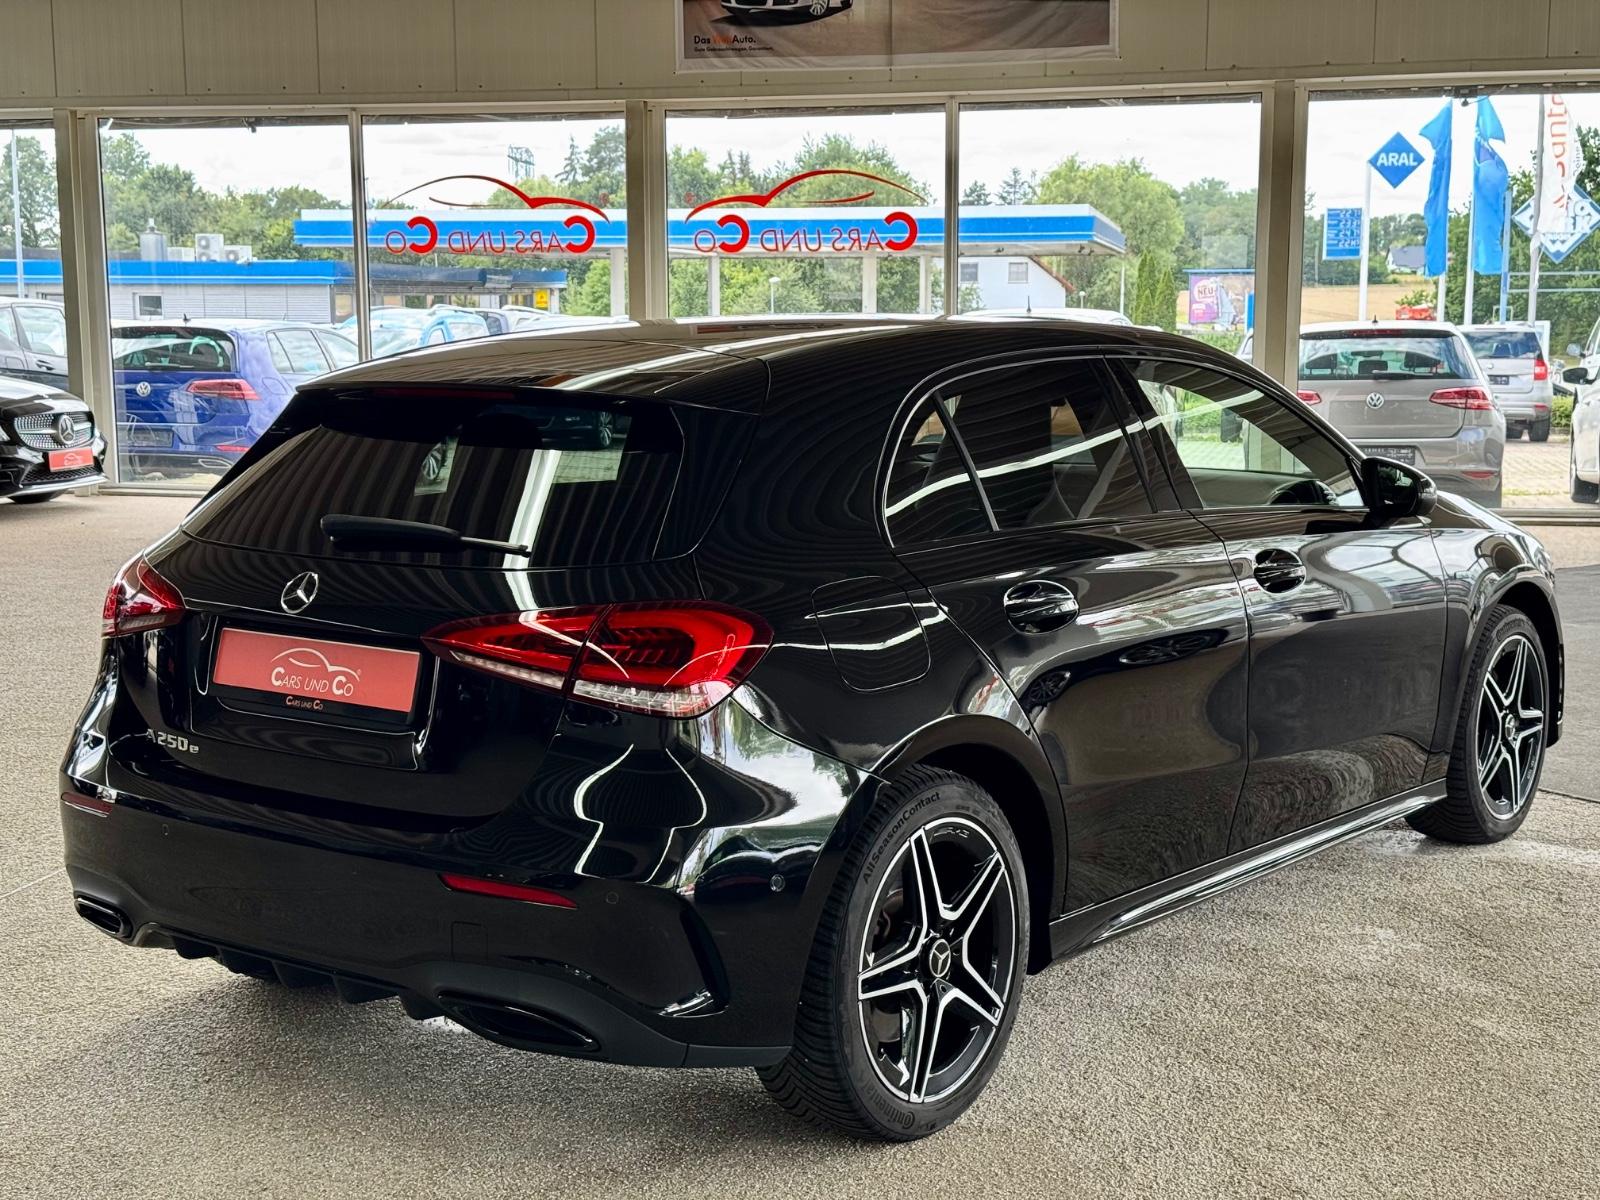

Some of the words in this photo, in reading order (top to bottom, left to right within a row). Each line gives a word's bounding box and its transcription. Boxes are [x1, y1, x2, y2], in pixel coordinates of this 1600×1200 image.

[694, 35, 711, 44] Das
[1376, 152, 1418, 166] ARAL
[304, 677, 329, 693] UND
[862, 791, 941, 884] AllSeasonContact
